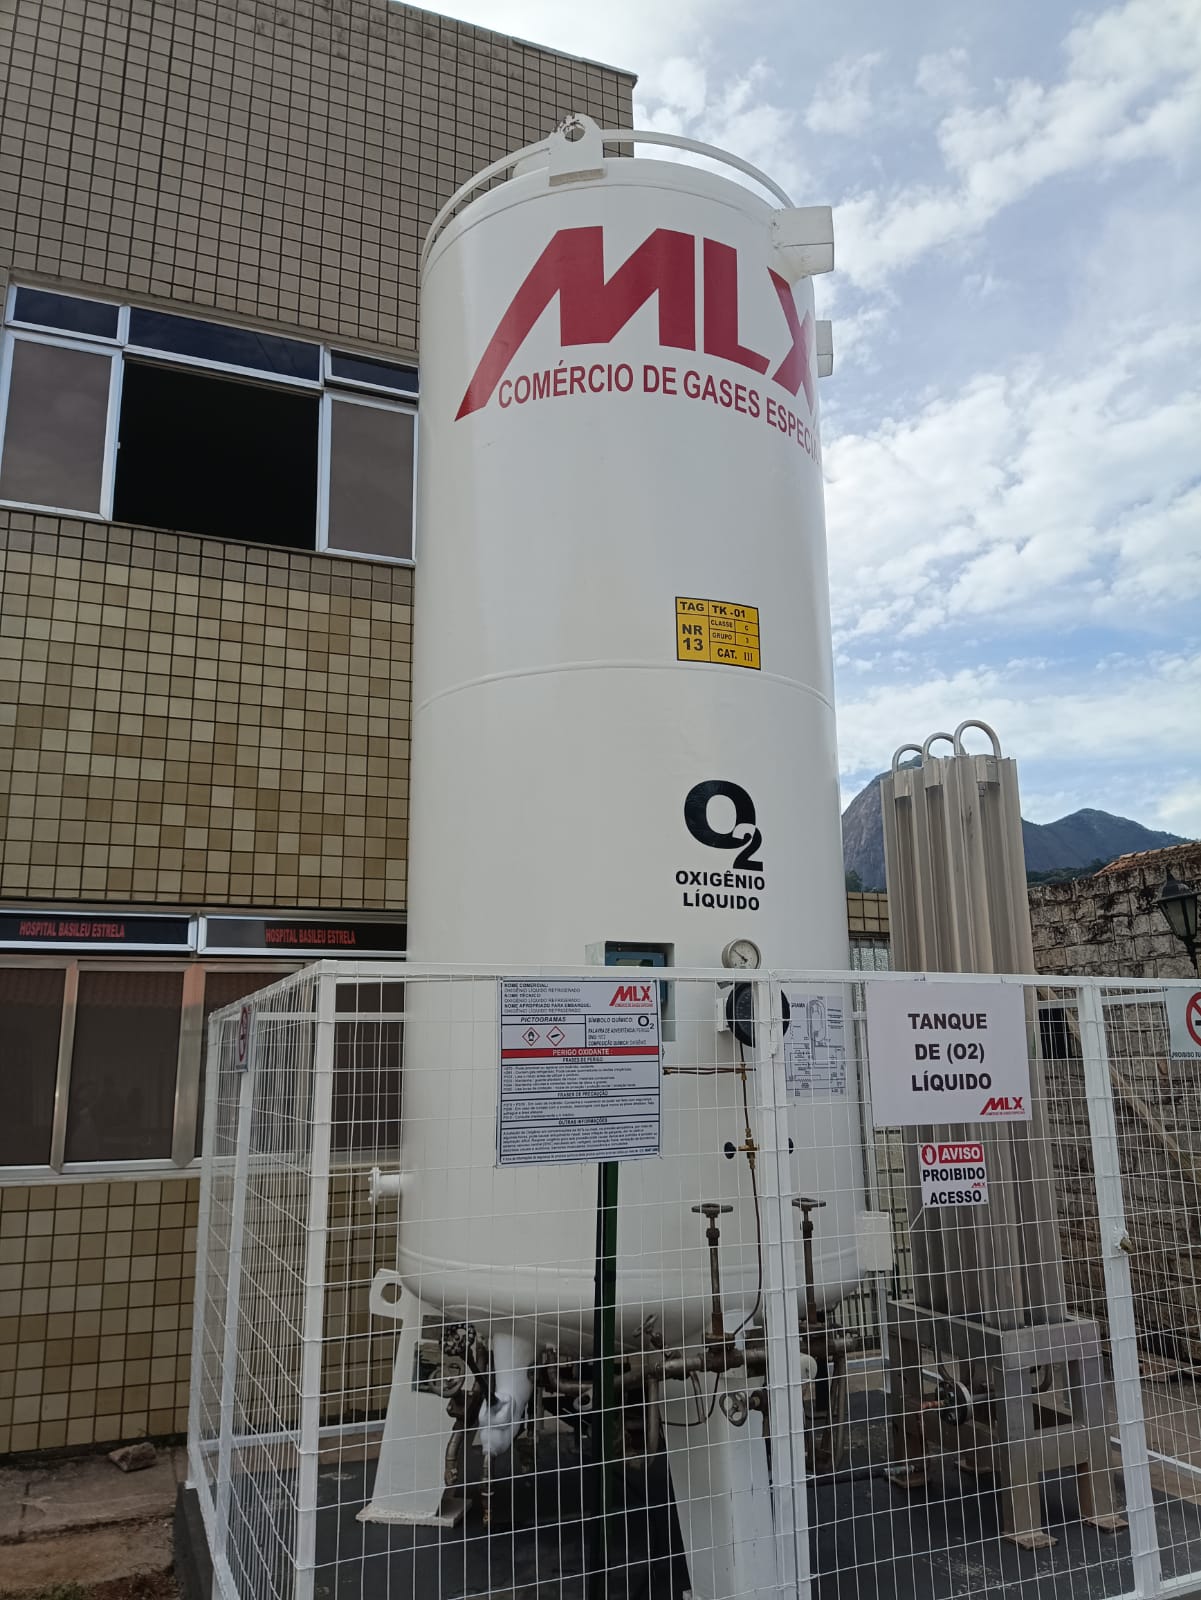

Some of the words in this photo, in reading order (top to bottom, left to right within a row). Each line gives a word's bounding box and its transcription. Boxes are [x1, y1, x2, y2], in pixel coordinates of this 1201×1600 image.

[454, 225, 814, 422] MLX
[499, 359, 633, 409] COMÉRCIO
[643, 364, 677, 395] DE
[683, 370, 760, 418] GASES
[679, 601, 705, 612] TAG
[682, 623, 703, 636] NR
[710, 619, 733, 629] CLASSE
[682, 637, 704, 652] 13
[712, 632, 733, 641] GRUPO
[717, 647, 738, 660] CAT.
[743, 651, 753, 662] III
[675, 870, 765, 890] OXIGÊNIO
[683, 889, 760, 911] LÍQUIDO
[20, 921, 57, 936] HOSPITAL
[58, 922, 91, 937] BASILEU
[92, 924, 125, 938] ESTRELA
[266, 928, 298, 943] HOSPITAL
[299, 929, 326, 944] BASILEU
[327, 930, 356, 945] ESTRELA
[609, 985, 651, 1006] MLX
[907, 1013, 988, 1031] TANQUE
[552, 1048, 577, 1056] PERIGO
[914, 1043, 941, 1061] DE
[947, 1043, 985, 1064] (O2)
[911, 1070, 992, 1092] LÍQUIDO
[980, 1097, 1023, 1115] MLX
[942, 1147, 981, 1161] AVISO
[922, 1167, 985, 1182] PROIBIDO
[930, 1190, 982, 1205] ACESSO
